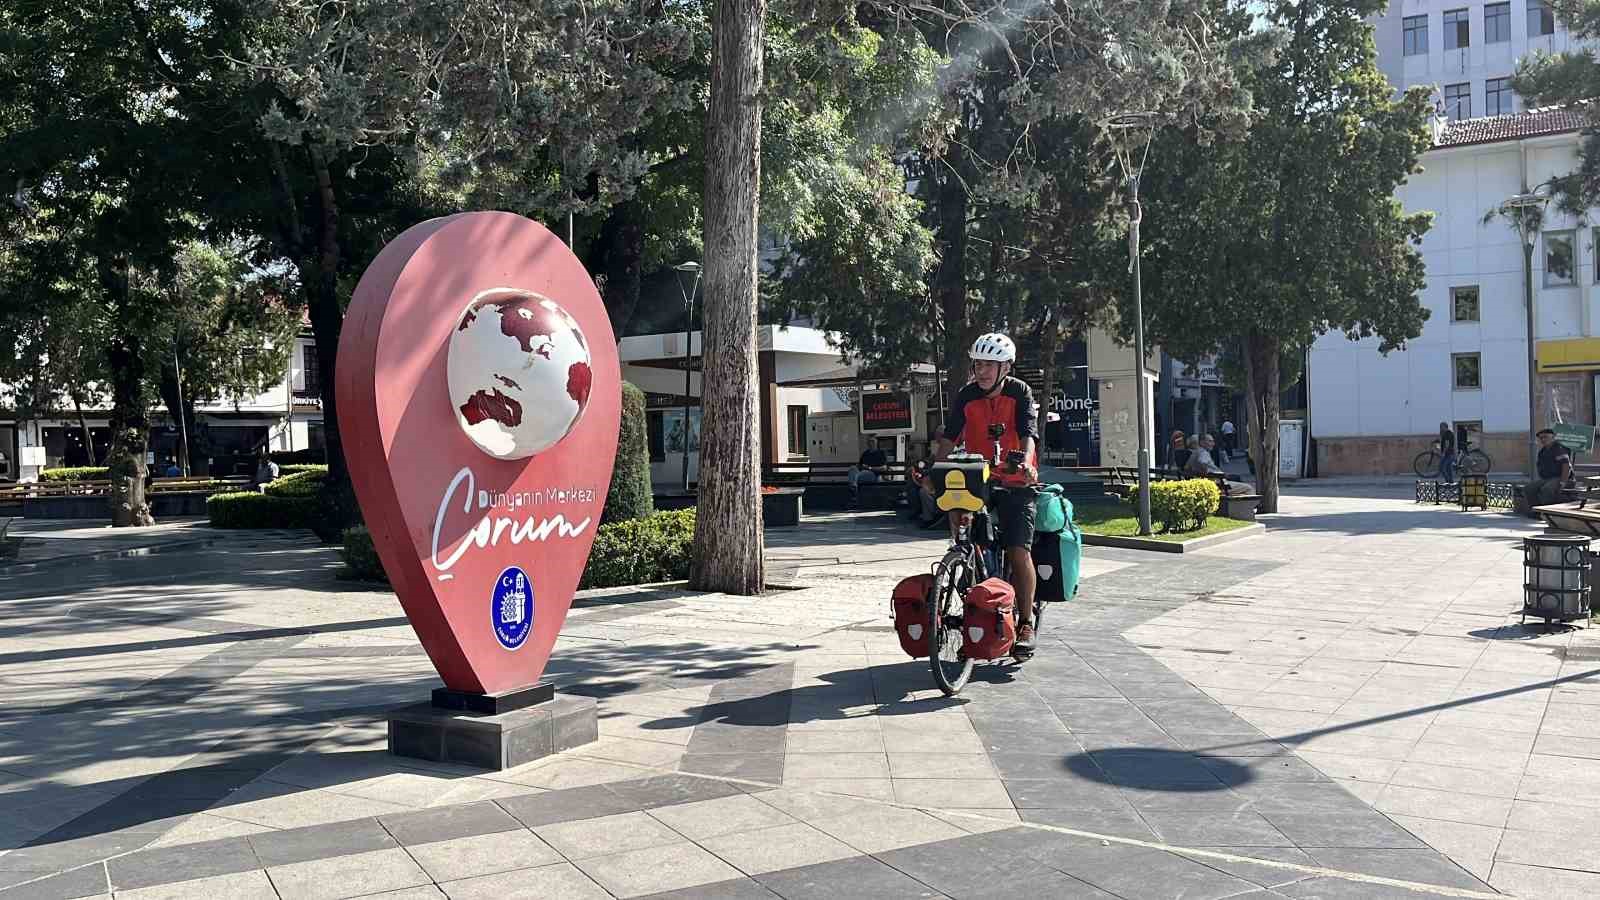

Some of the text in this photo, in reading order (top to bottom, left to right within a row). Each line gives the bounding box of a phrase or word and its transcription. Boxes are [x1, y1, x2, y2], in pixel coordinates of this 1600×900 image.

[431, 466, 592, 582] Çorum
[478, 487, 597, 512] Dünyanın Merkezi
